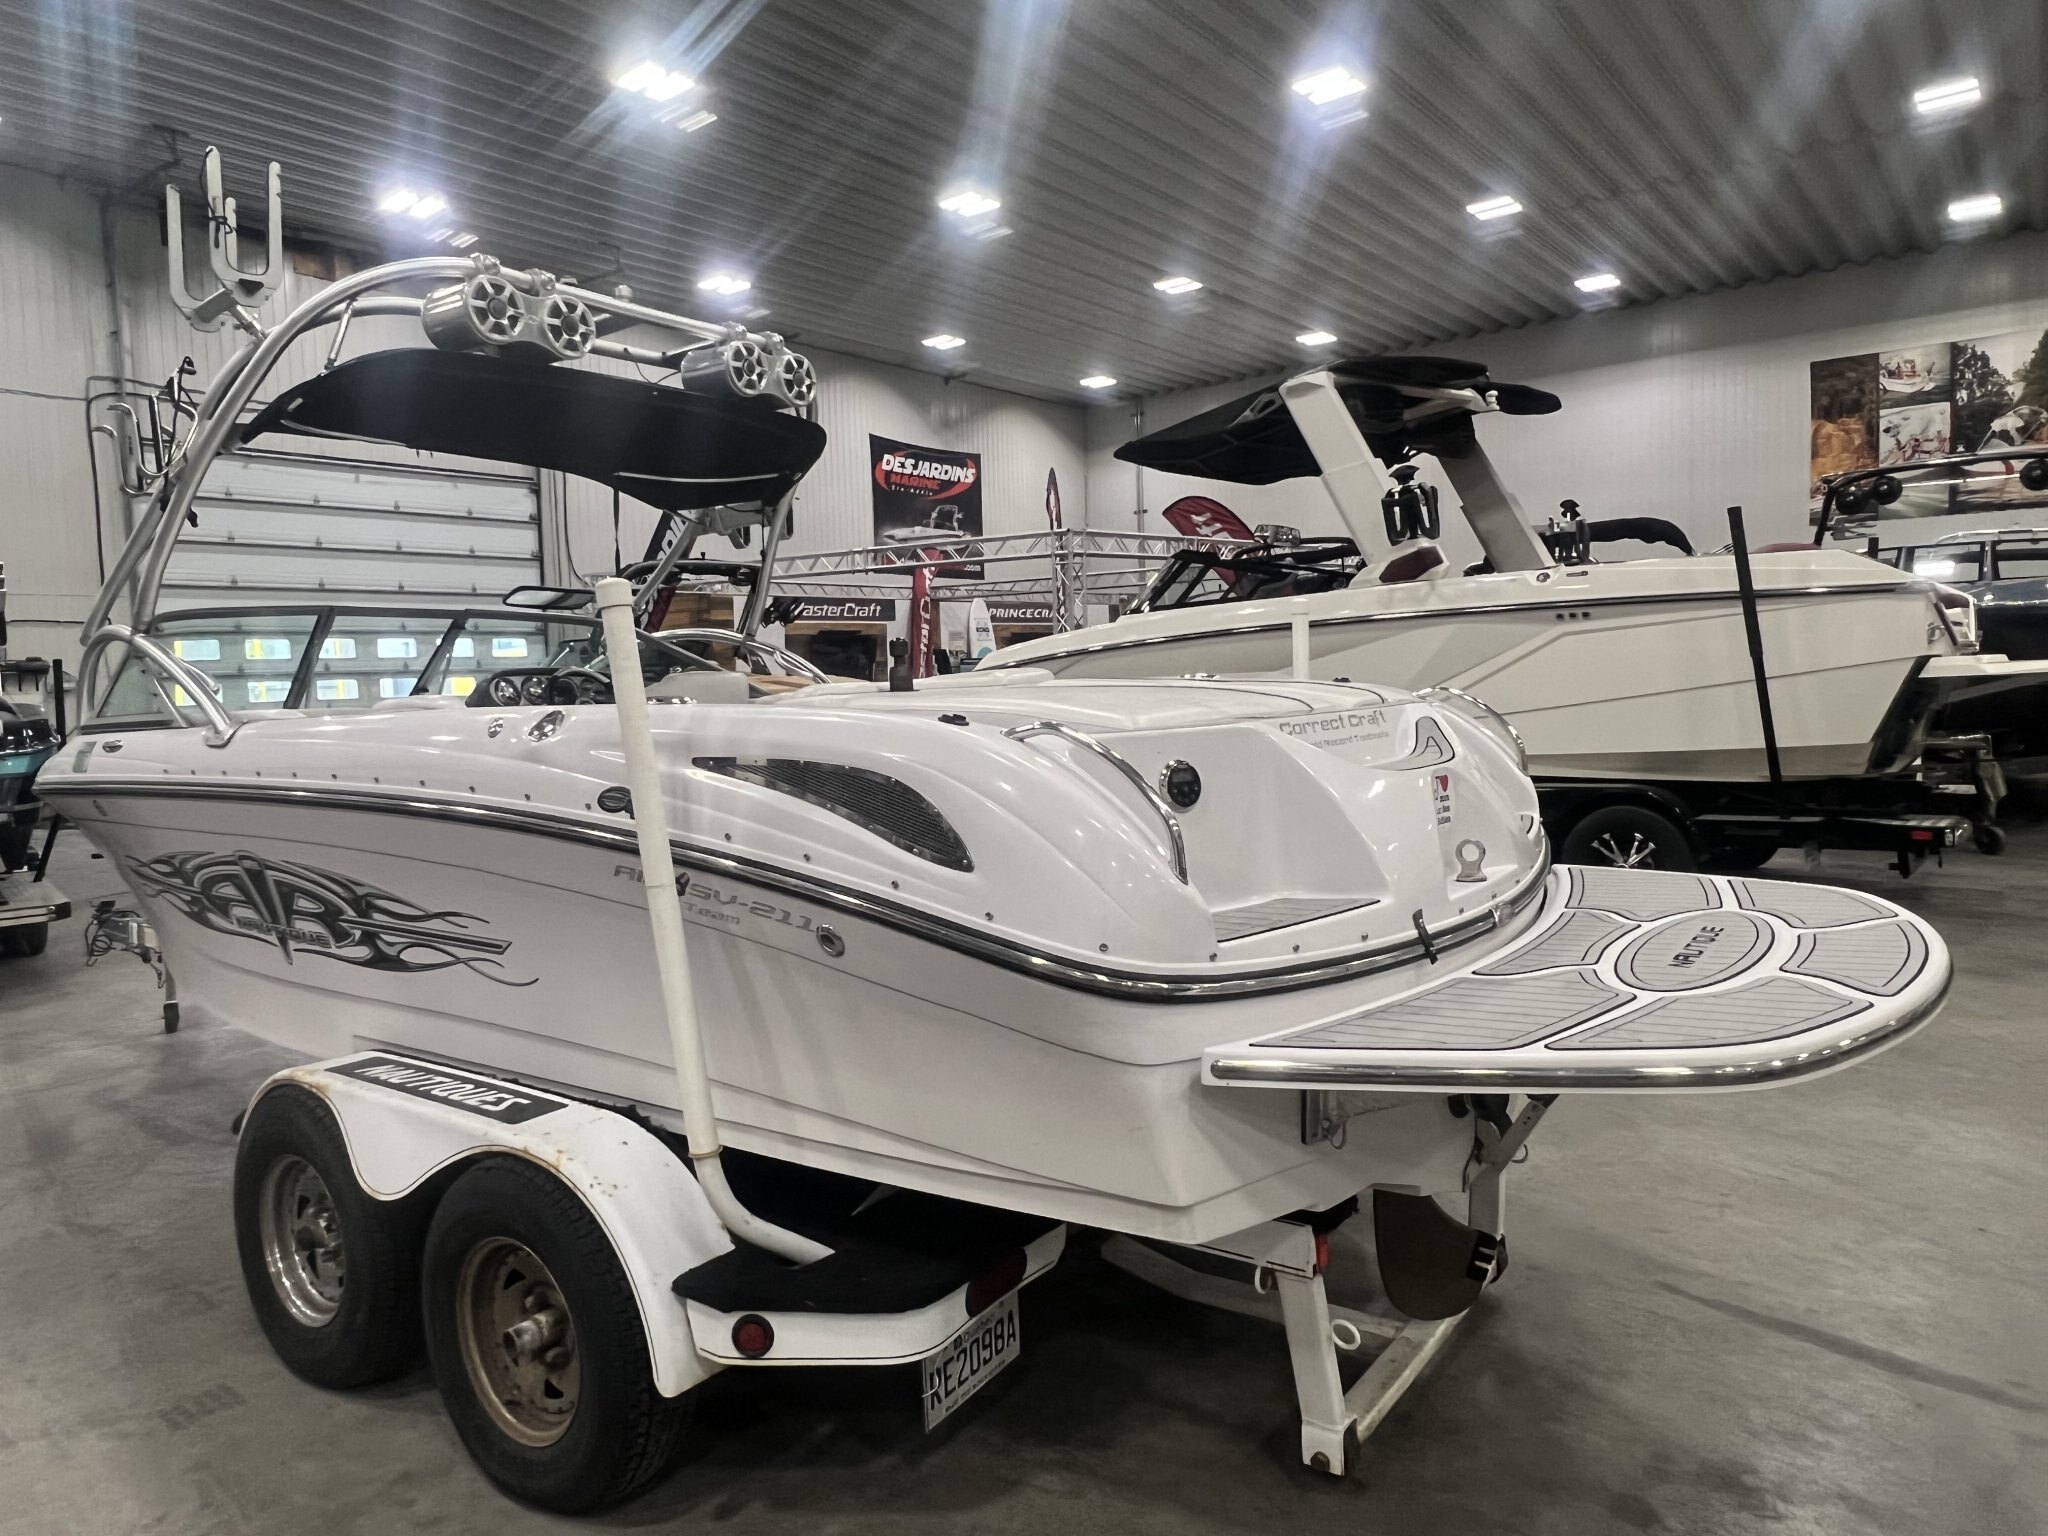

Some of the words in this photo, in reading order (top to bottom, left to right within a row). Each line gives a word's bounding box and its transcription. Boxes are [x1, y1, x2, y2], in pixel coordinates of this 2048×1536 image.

[881, 453, 976, 483] DESJARDINS
[890, 473, 942, 490] MARINE
[1279, 714, 1346, 736] Correct
[1347, 710, 1387, 728] Craft
[688, 882, 816, 933] SV-211
[354, 1064, 533, 1111] NAUTIQUES
[929, 1309, 1016, 1411] RE2098A
